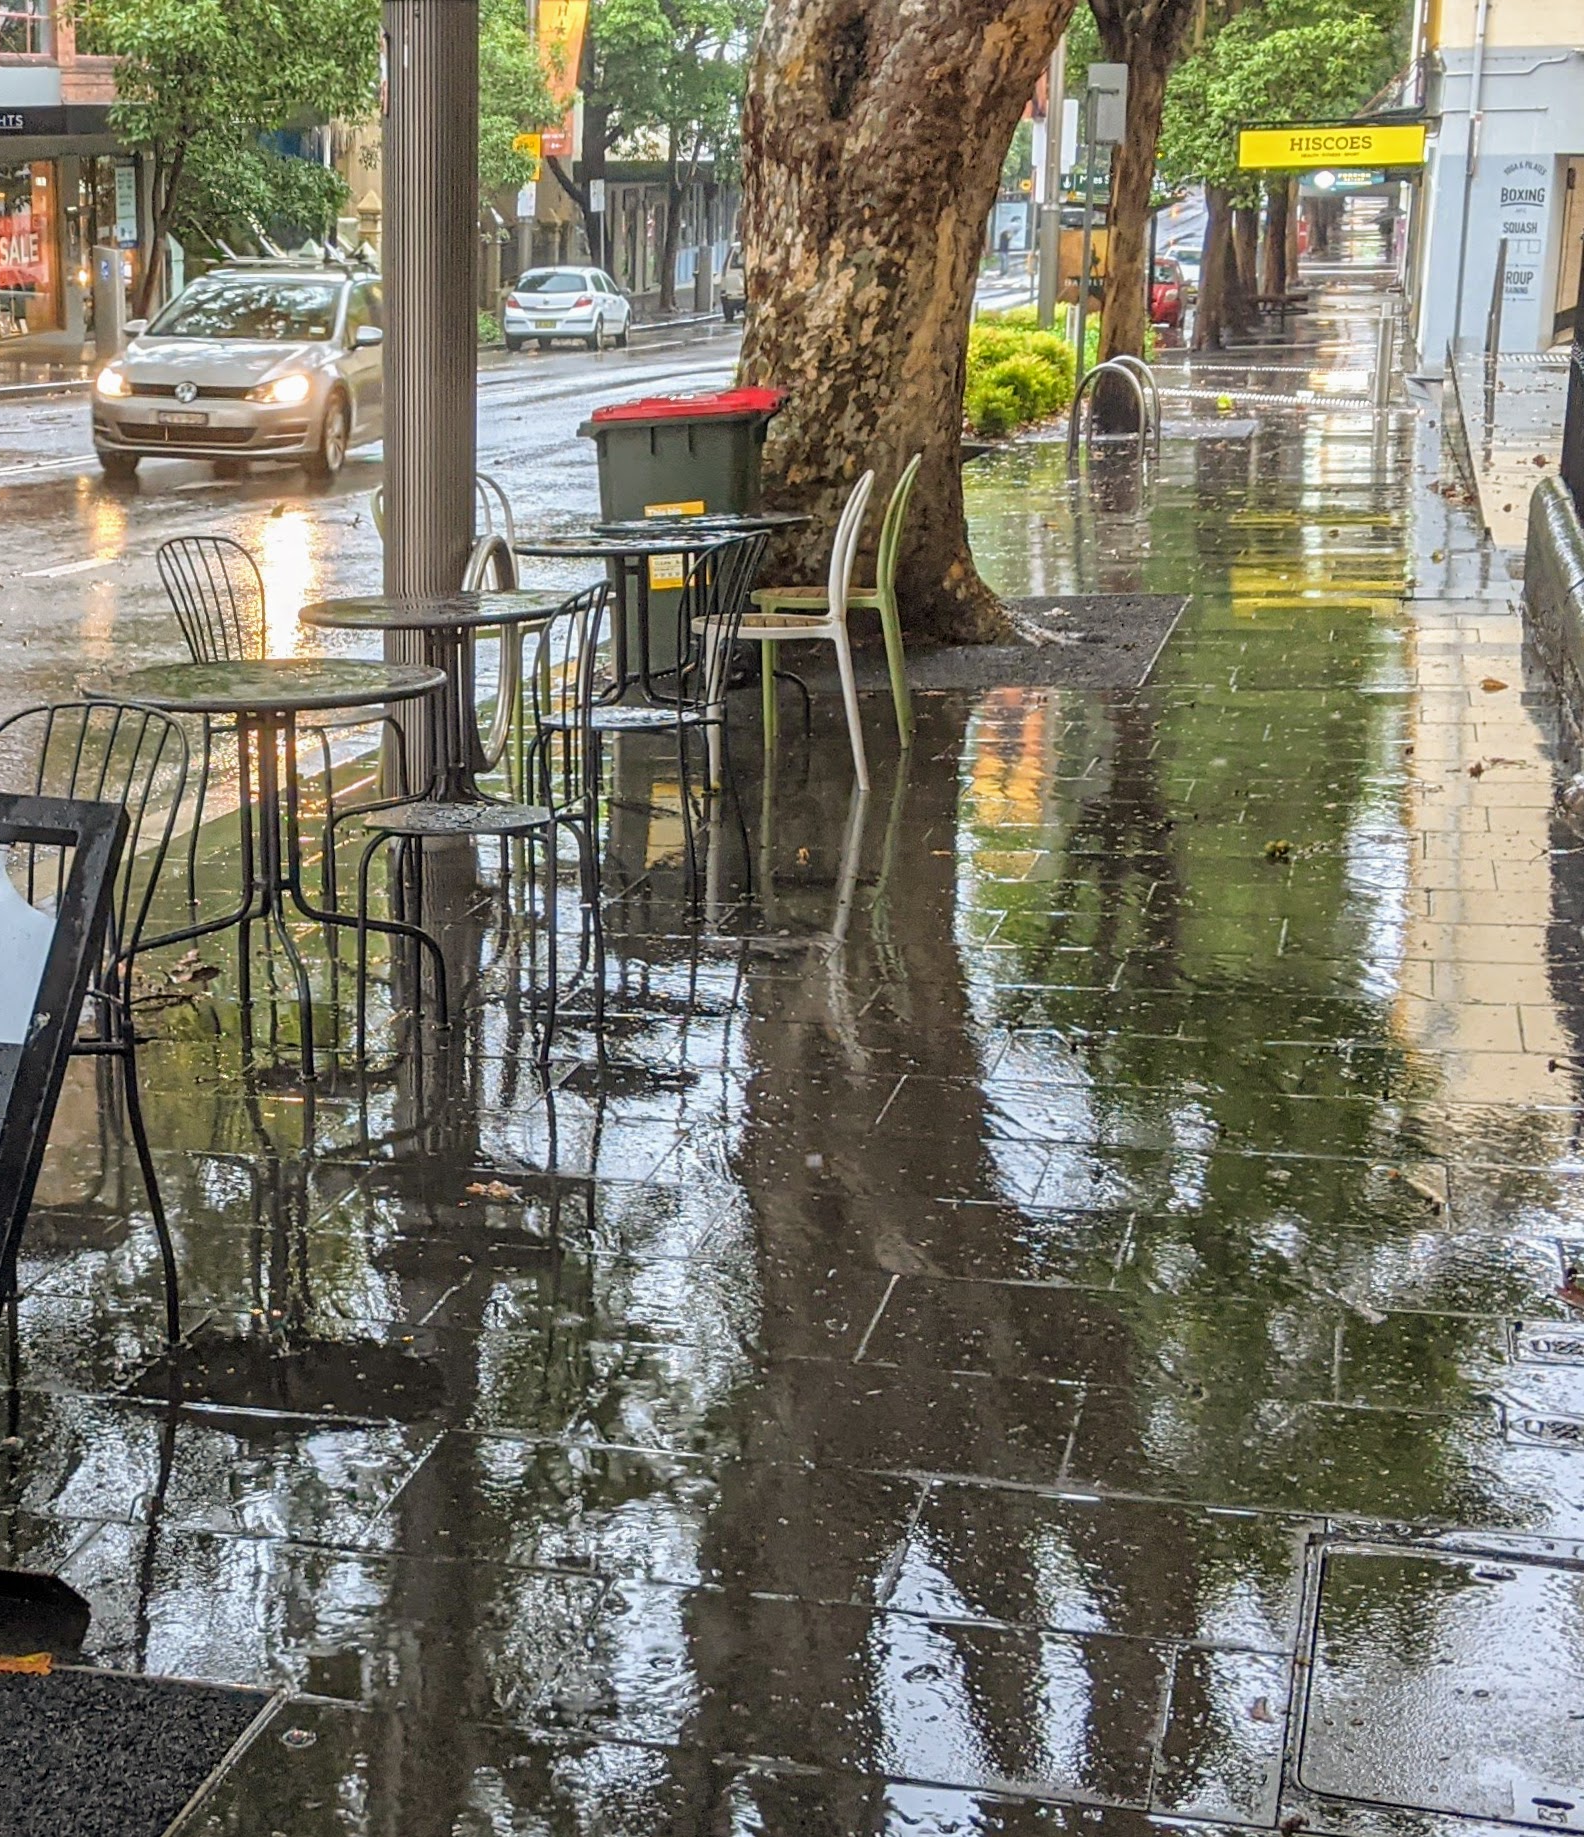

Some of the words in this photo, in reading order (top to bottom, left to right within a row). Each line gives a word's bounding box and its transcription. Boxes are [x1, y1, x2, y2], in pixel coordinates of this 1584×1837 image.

[1289, 135, 1373, 152] HISCOES
[1503, 162, 1519, 176] YOGA
[1500, 187, 1546, 203] BOXING
[1502, 221, 1538, 234] SQUASH
[1505, 270, 1535, 285] ROUP
